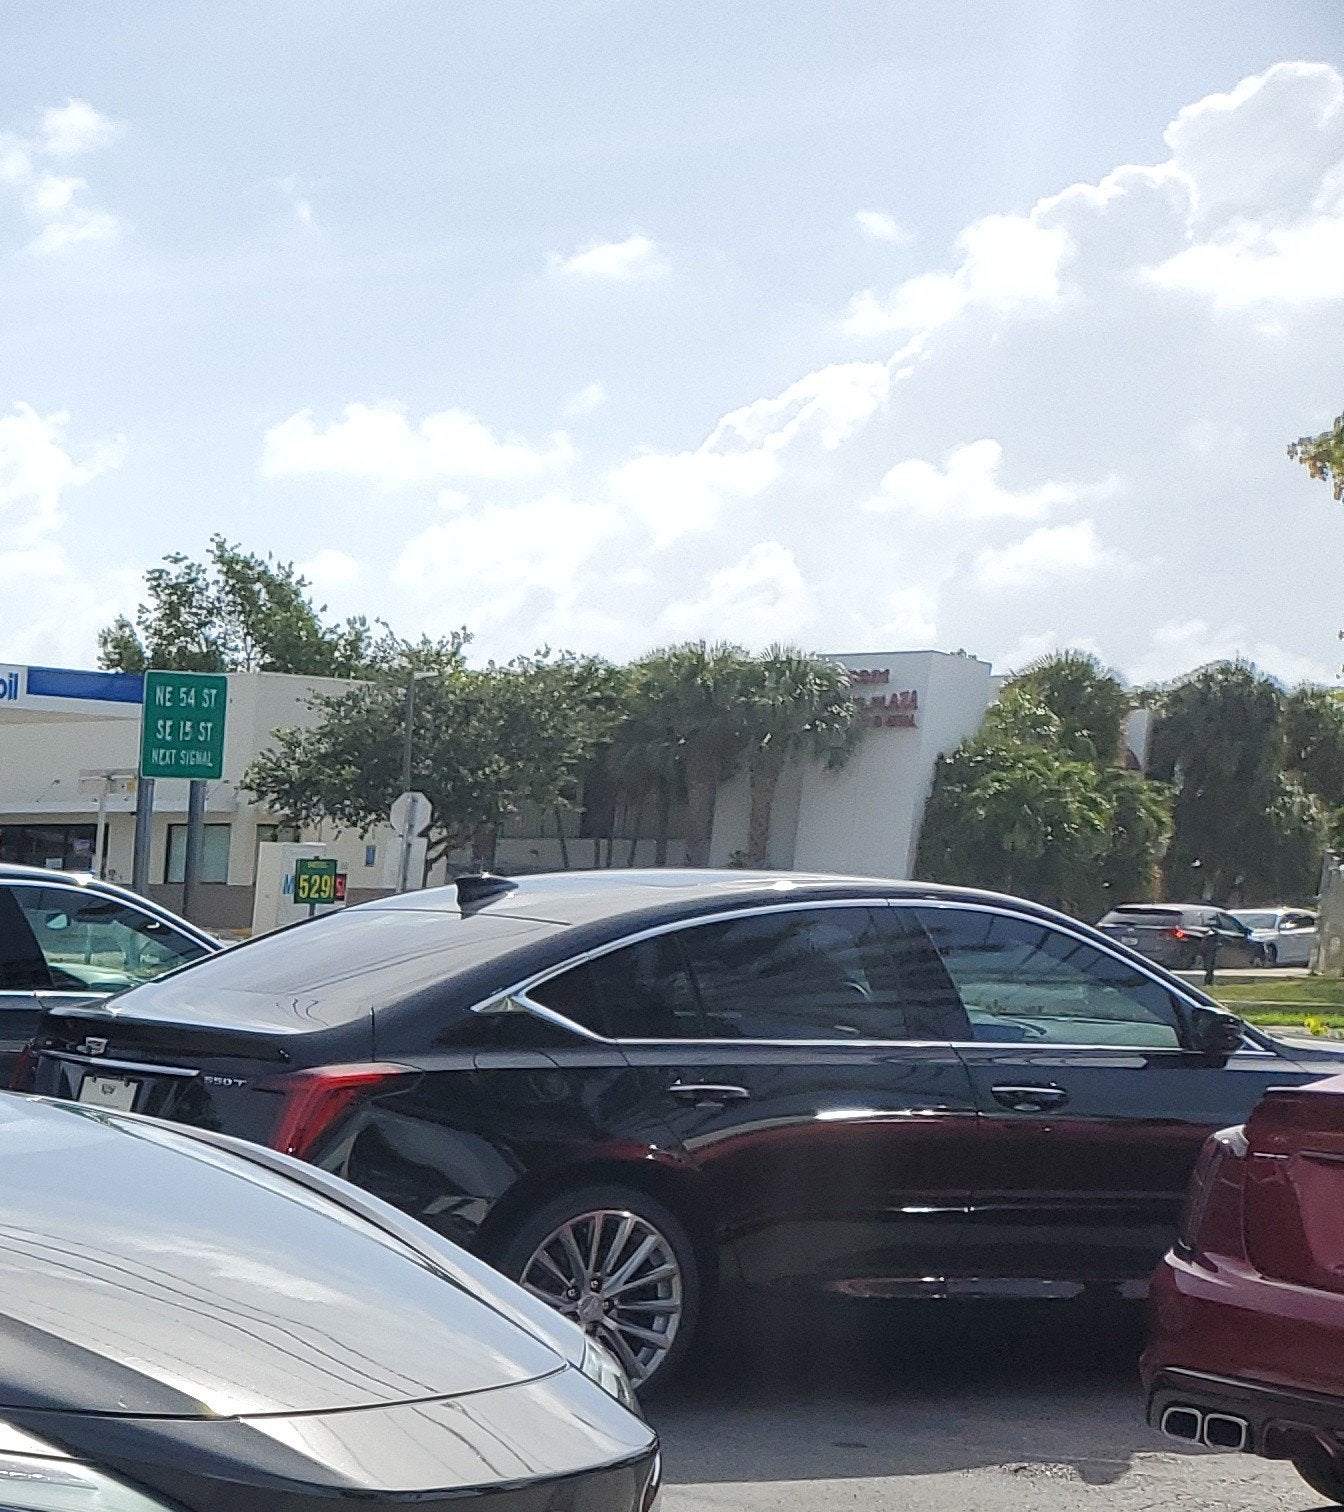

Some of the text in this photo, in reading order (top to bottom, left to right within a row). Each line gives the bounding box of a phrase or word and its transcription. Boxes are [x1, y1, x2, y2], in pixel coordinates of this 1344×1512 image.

[155, 685, 217, 708] NE 54 ST
[156, 719, 173, 741] SE
[198, 721, 213, 742] ST
[152, 747, 214, 768] NEXT SIGNAL
